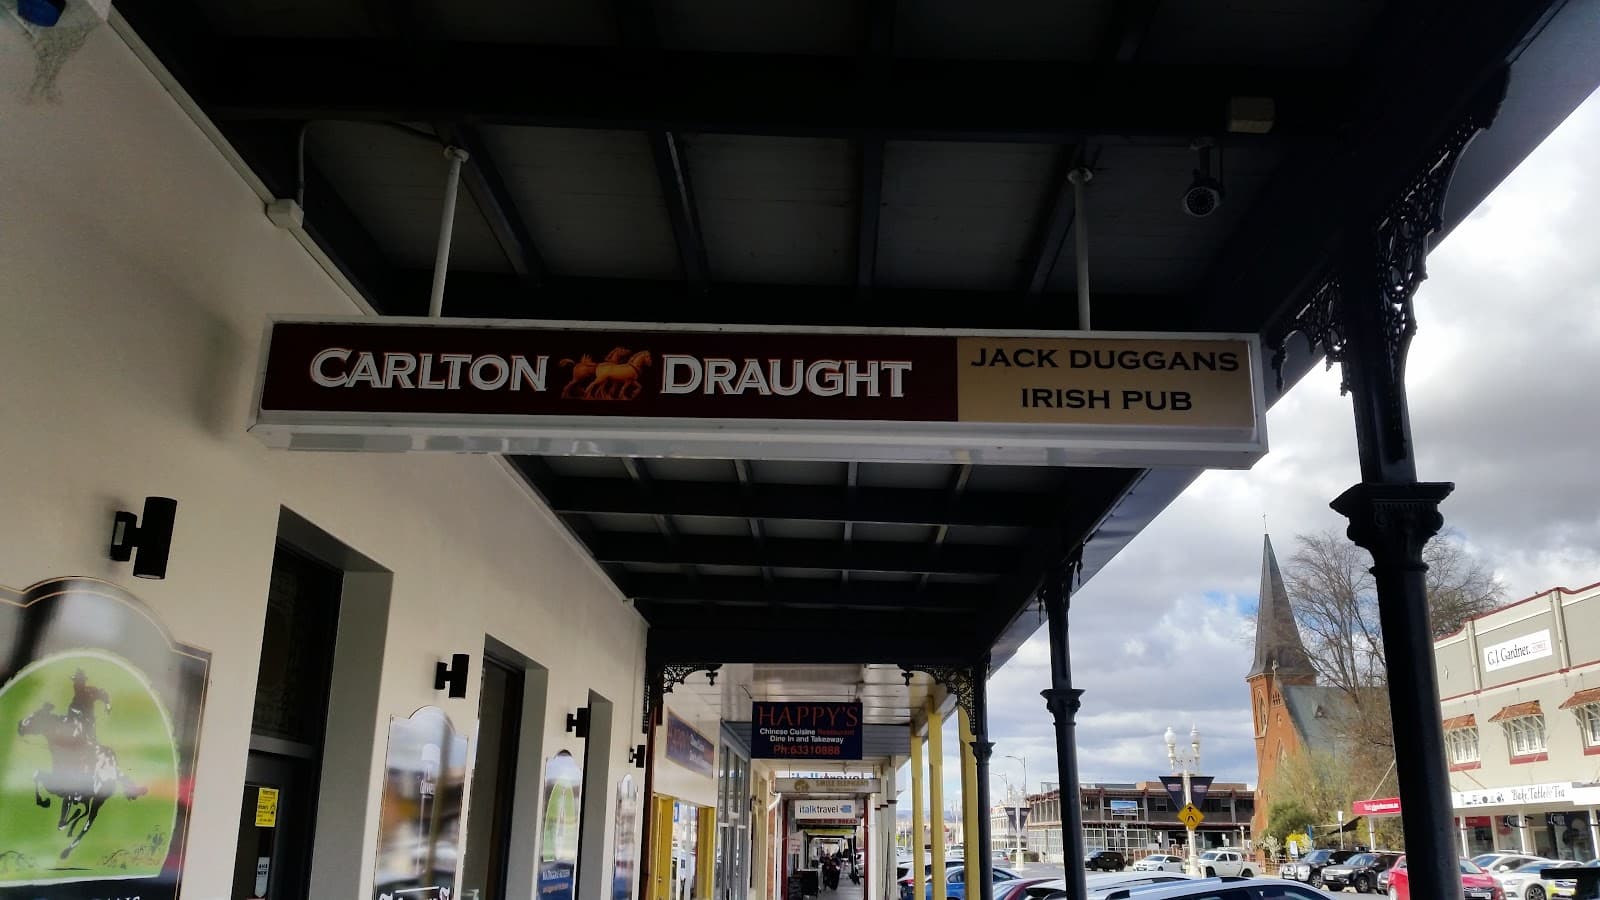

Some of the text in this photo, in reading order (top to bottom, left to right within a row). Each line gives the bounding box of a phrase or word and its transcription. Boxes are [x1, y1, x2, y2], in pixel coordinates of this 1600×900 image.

[970, 347, 1240, 372] JACK DUGGANS
[310, 348, 912, 398] CARLTON DRAUGHT
[1021, 387, 1193, 412] IRISH PUB
[758, 704, 858, 727] HAPPY'S
[759, 727, 788, 735] Chinese
[789, 728, 816, 736] Cuisine
[796, 735, 809, 743] and
[811, 735, 844, 744] Takeaway
[799, 804, 839, 814] italktravel
